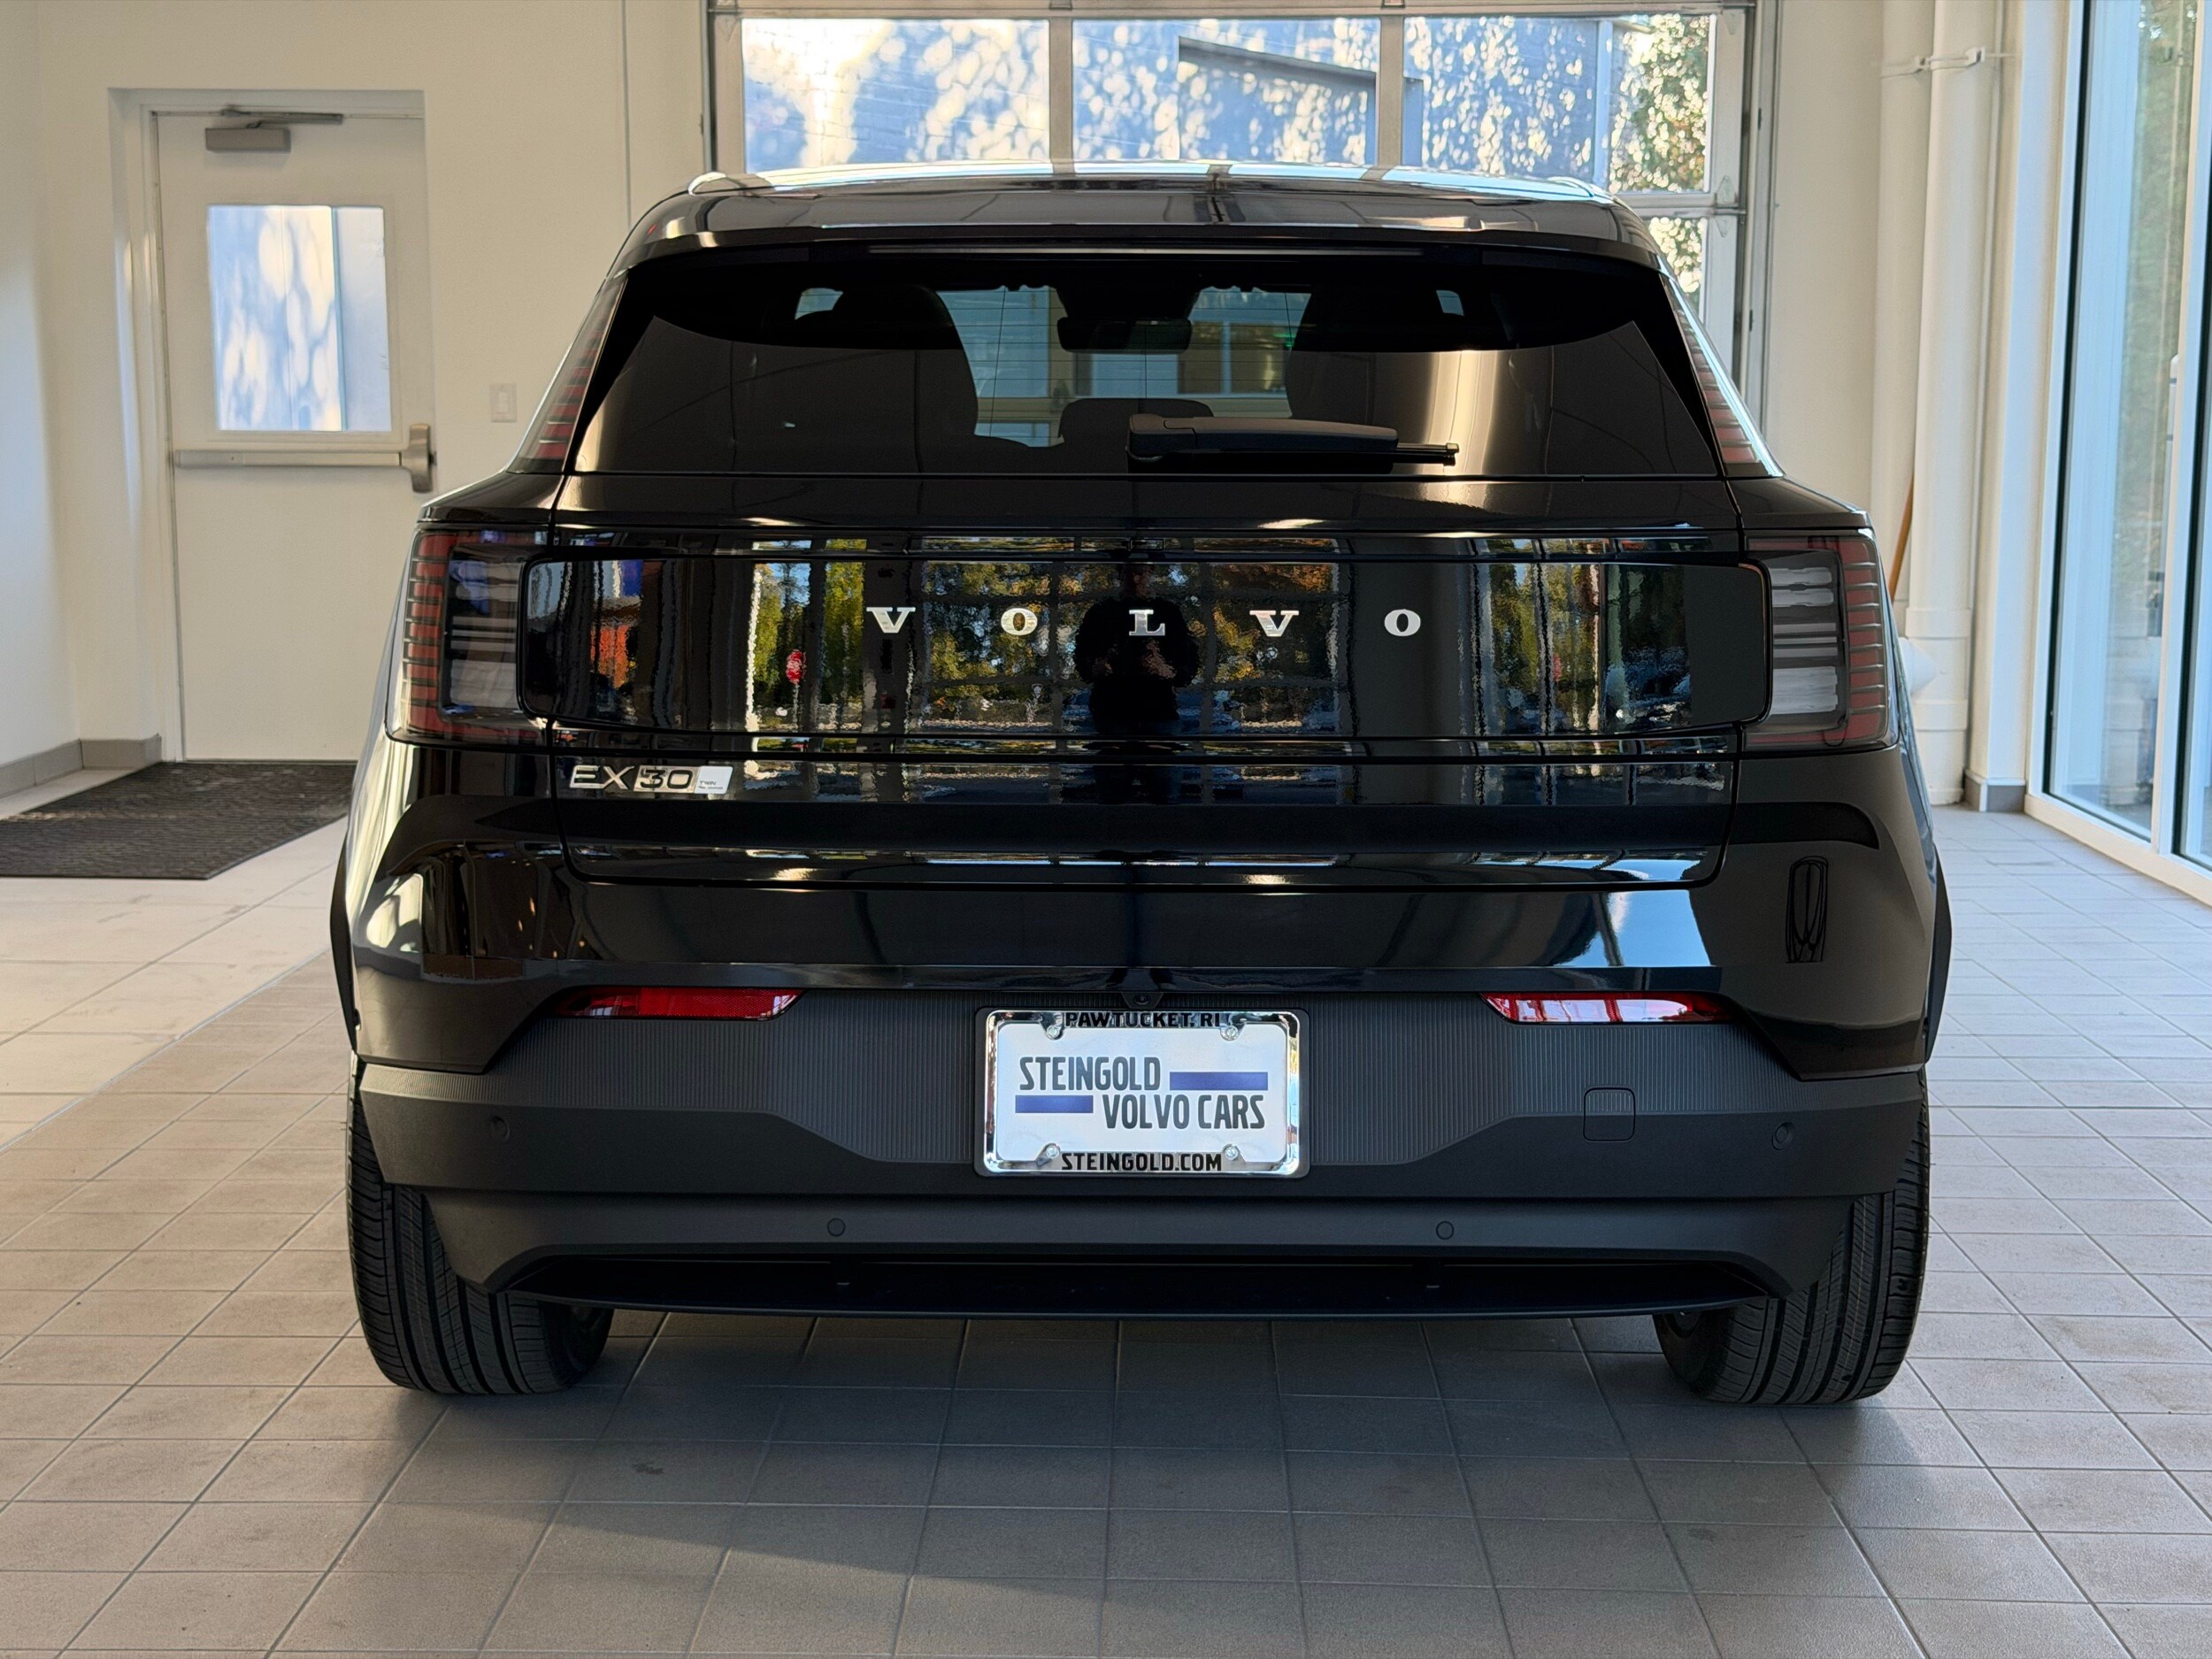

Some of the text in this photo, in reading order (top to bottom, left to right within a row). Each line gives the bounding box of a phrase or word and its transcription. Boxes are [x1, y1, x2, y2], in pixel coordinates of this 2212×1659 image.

[866, 606, 1421, 636] VOLVO
[569, 764, 694, 790] EX30
[1200, 1011, 1220, 1027] RI
[1019, 1056, 1161, 1091] STEINGOLD
[1102, 1094, 1265, 1129] VOLVO CARS
[1062, 1153, 1222, 1171] STEINGOLD.COM
